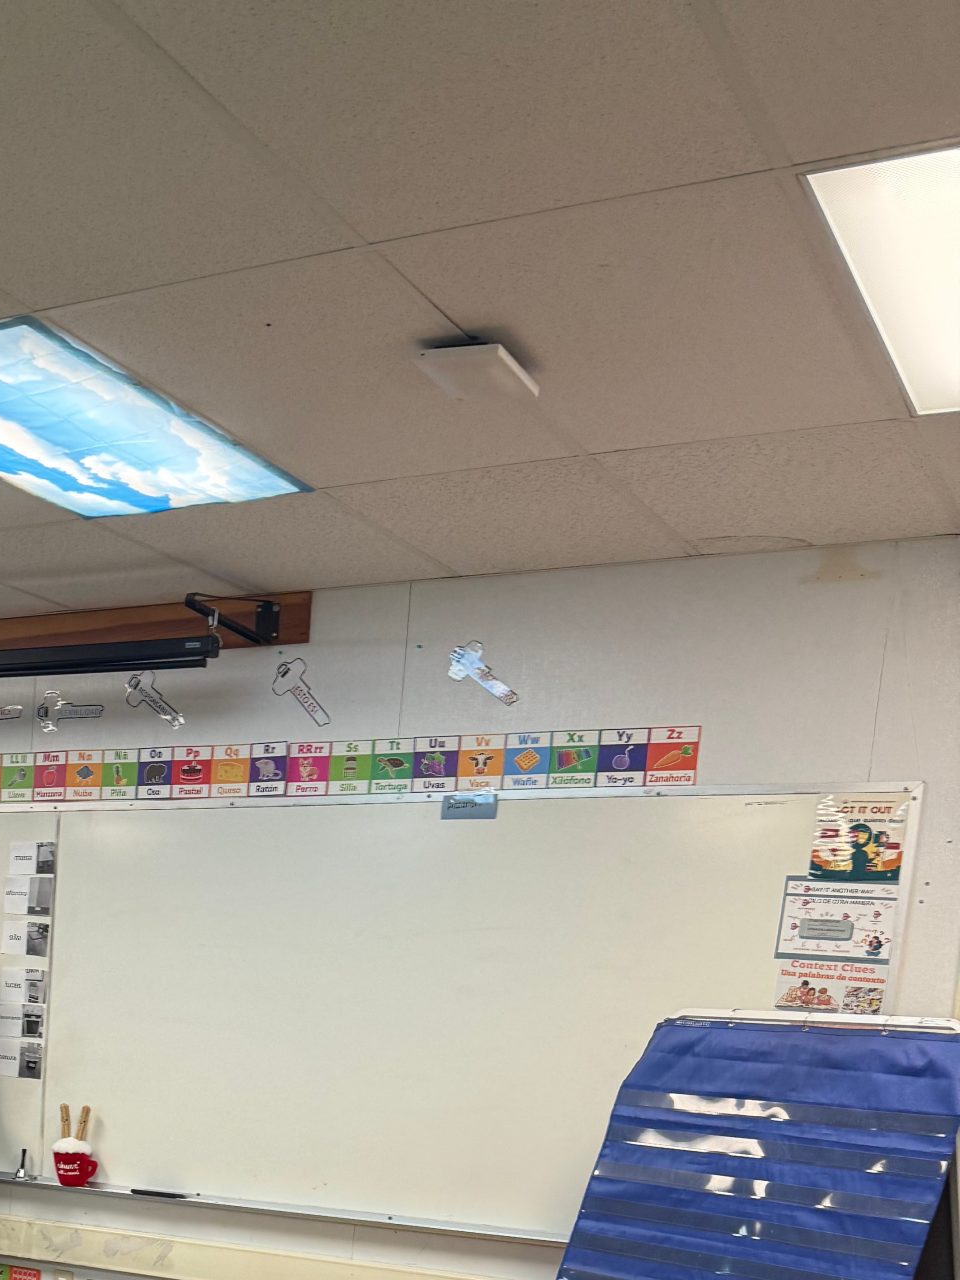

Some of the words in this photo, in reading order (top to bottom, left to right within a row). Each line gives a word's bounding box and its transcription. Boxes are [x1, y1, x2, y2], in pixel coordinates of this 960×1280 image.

[567, 733, 584, 743] Xx
[617, 731, 633, 743] Yy
[666, 728, 683, 740] Zz
[346, 742, 359, 753] Ss
[185, 748, 200, 758] Pp
[423, 781, 445, 789] Uvas
[871, 806, 894, 814] OUT
[791, 960, 839, 971] Context
[841, 963, 876, 974] Clues
